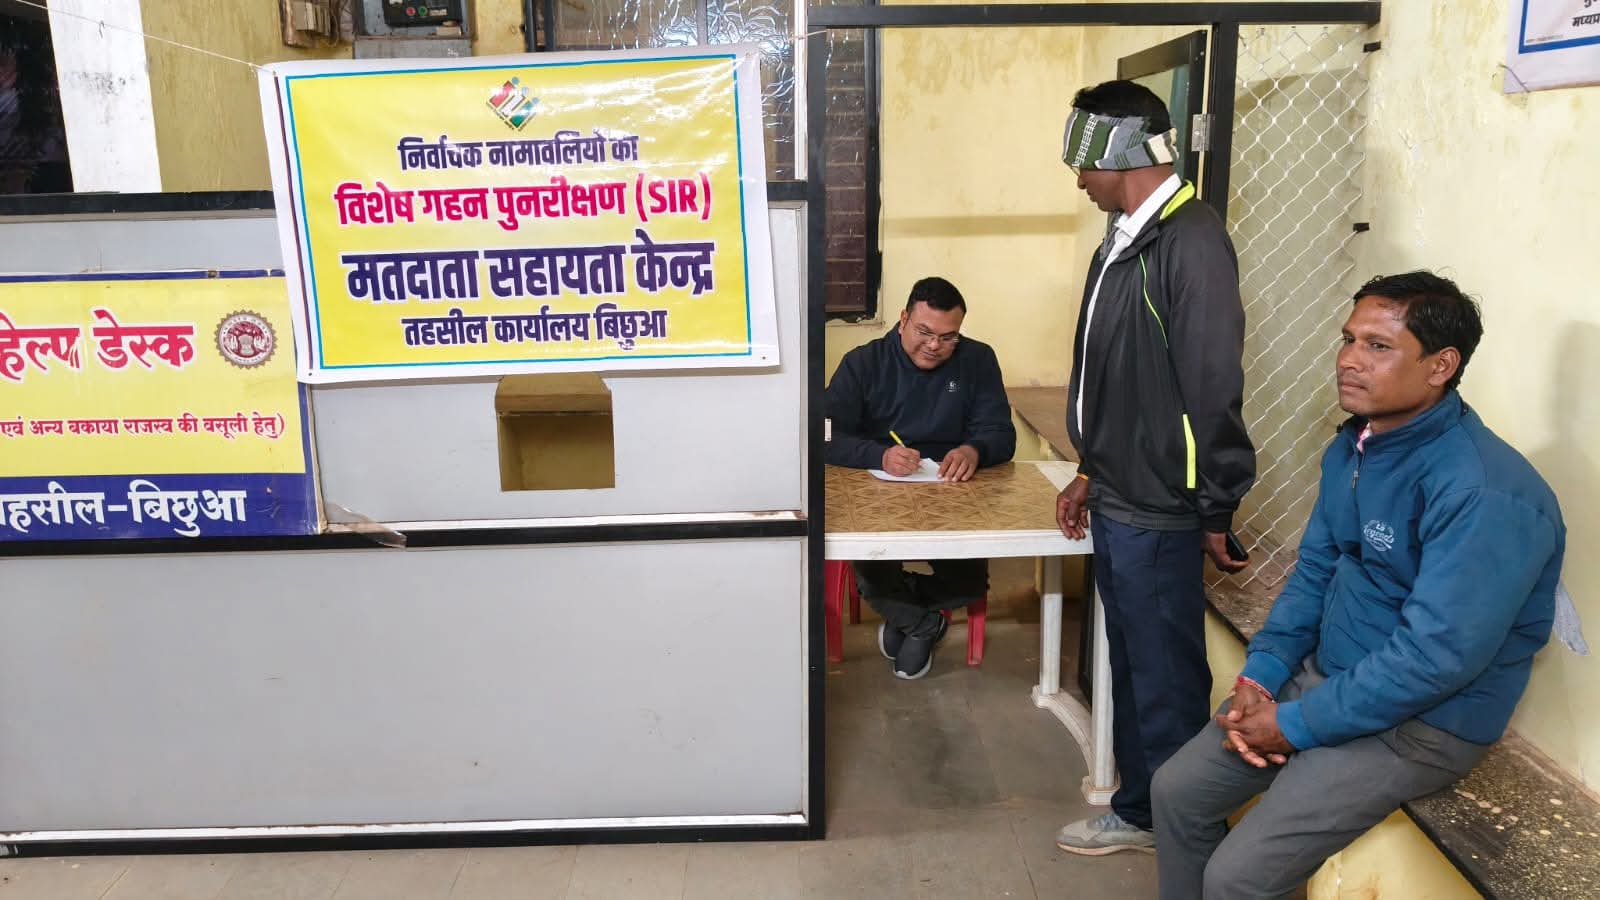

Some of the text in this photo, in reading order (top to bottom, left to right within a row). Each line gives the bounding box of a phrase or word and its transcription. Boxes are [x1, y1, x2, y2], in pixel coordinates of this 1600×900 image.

[397, 130, 638, 170] निर्वाचक नामावलियो का
[334, 172, 711, 230] विशेष गहन पुनरीक्षण (SIR)
[342, 229, 715, 300] मतदाता सहायता केन्द्र
[93, 309, 193, 368] डेस्क
[402, 303, 667, 350] तहसील कार्यालय बिछुआ
[0, 416, 24, 437] एवं
[30, 420, 63, 435] अन्य
[123, 418, 173, 433] राजस्व
[177, 413, 198, 432] की
[202, 413, 248, 439] वसूली
[252, 411, 285, 438] हेतु)
